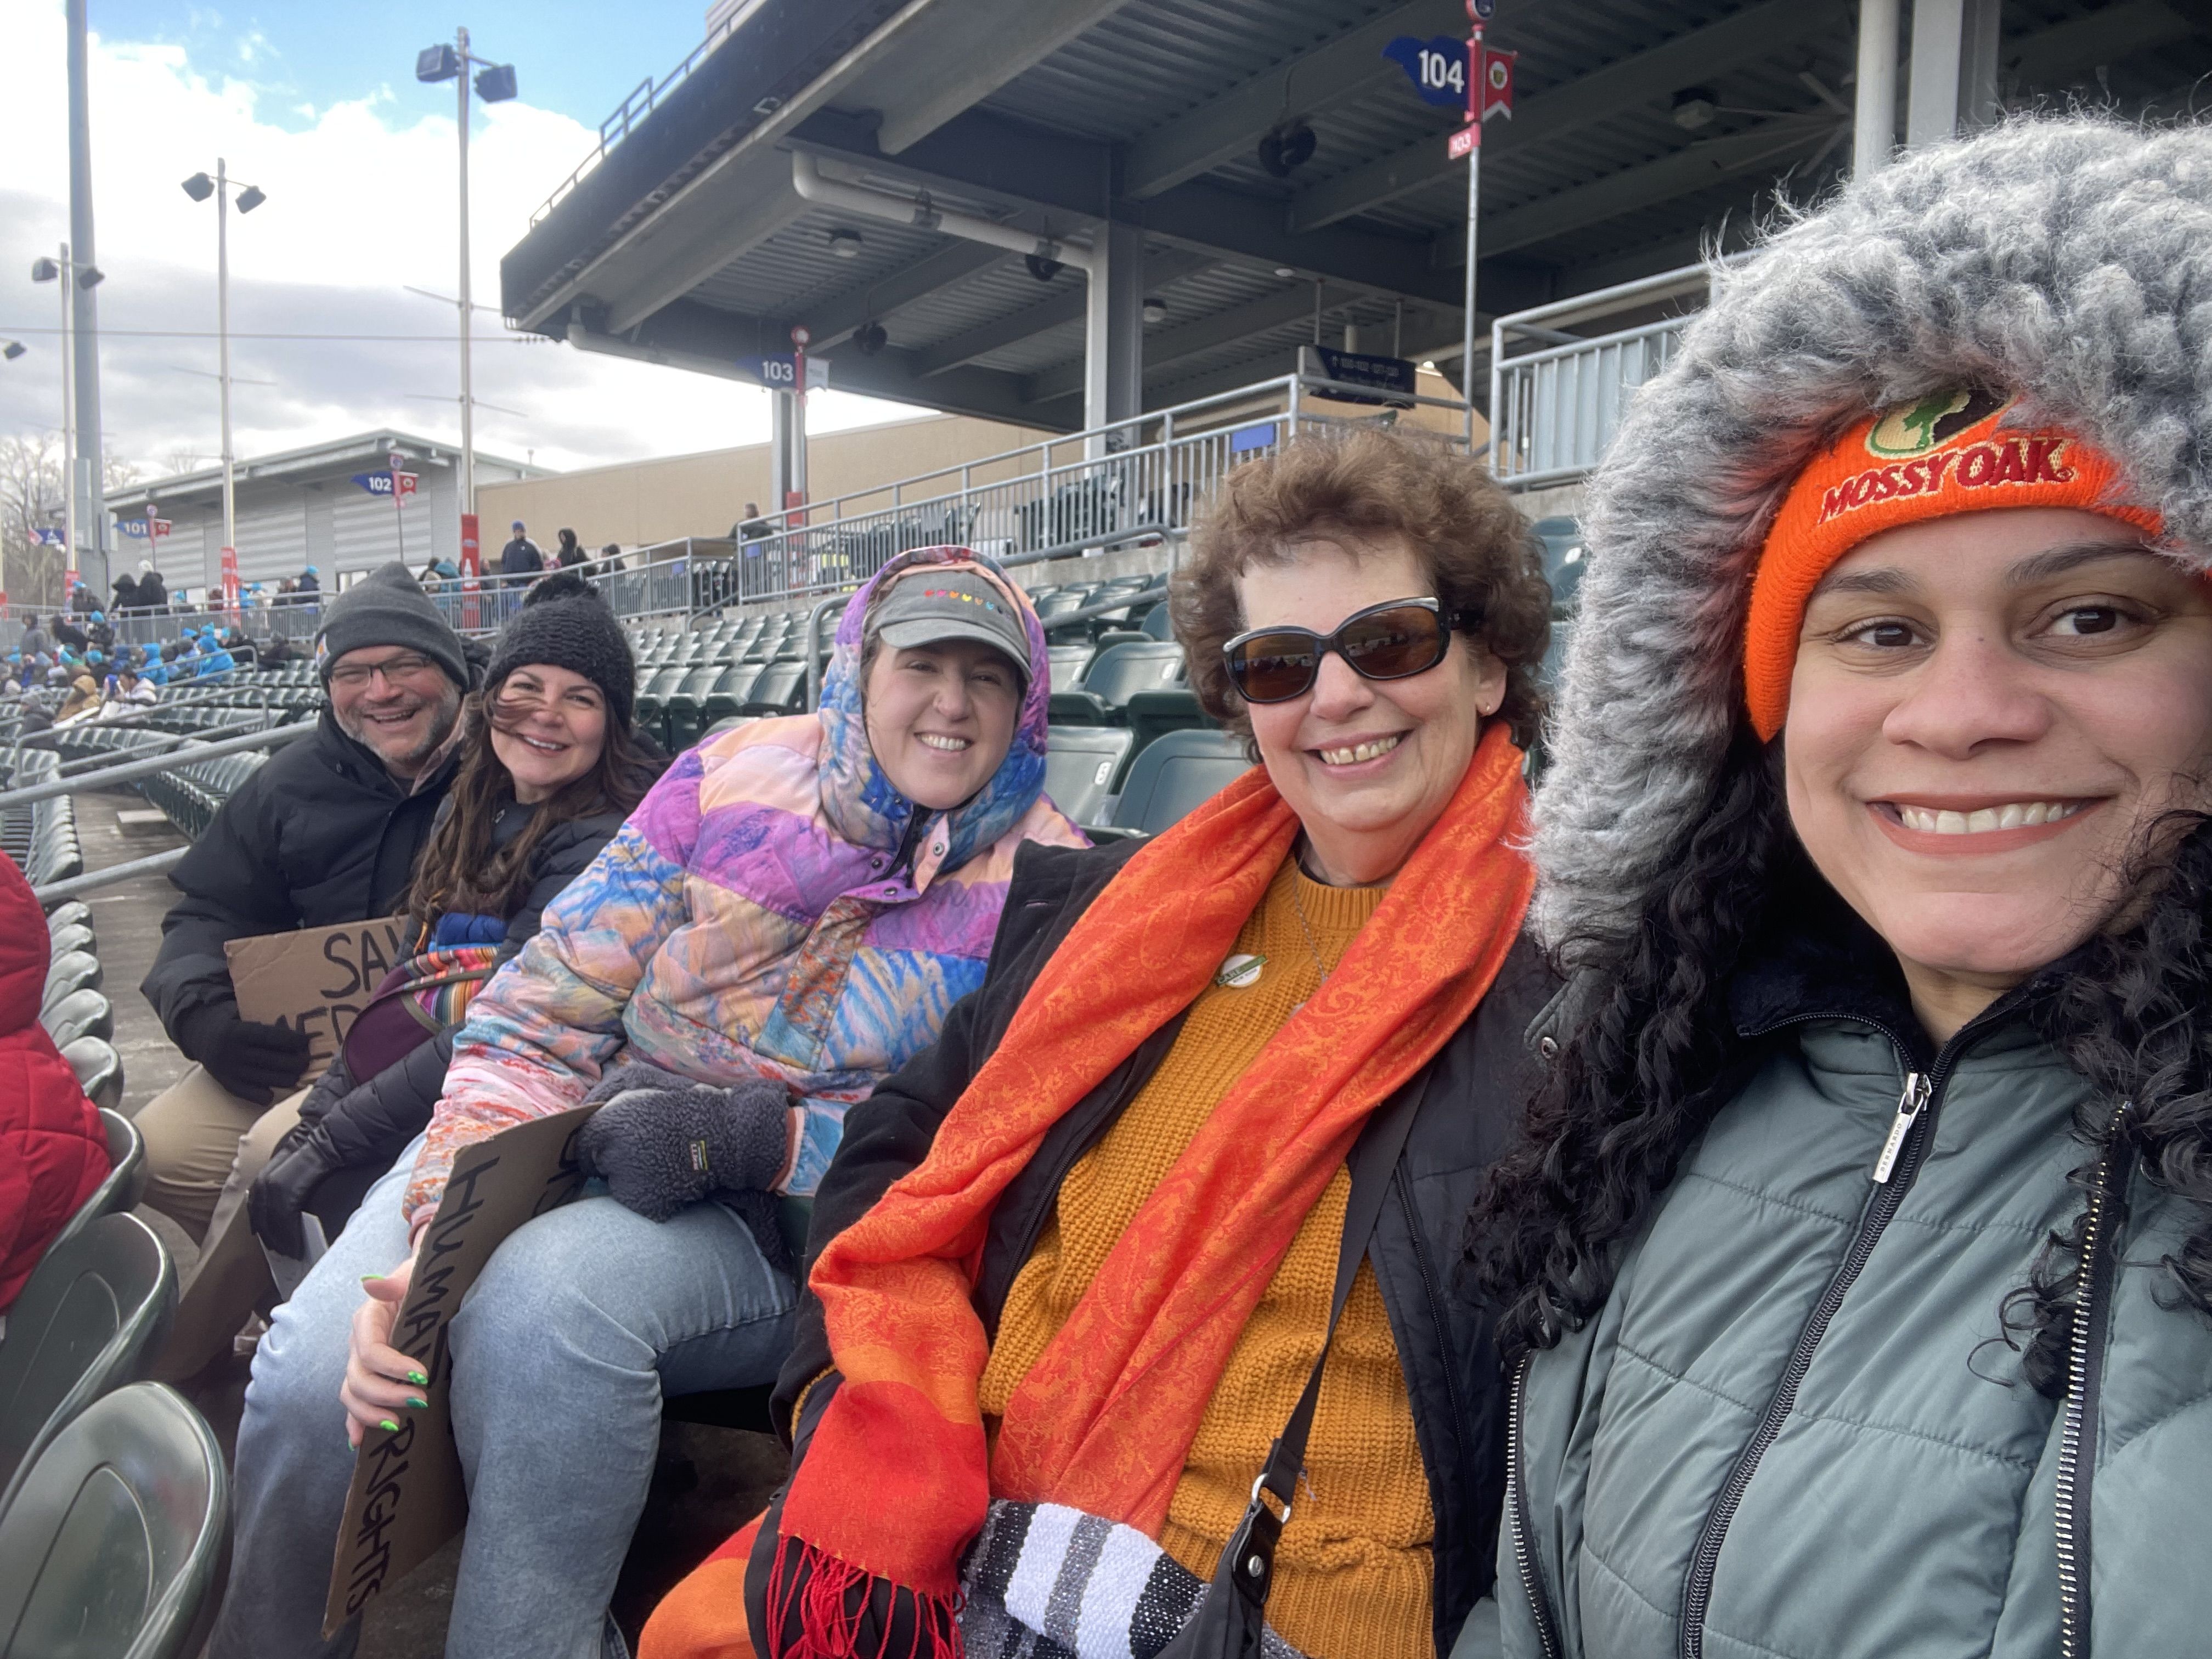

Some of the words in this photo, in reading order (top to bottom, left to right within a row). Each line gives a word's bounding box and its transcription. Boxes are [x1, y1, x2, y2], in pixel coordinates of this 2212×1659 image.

[1418, 49, 1465, 94] 104
[763, 360, 793, 382] 103
[369, 477, 392, 492] 102
[1818, 451, 1958, 525] MOSSY
[1955, 439, 2066, 487] OAK
[125, 522, 146, 535] 101
[1880, 1122, 1902, 1173] BERNARDO
[399, 1155, 500, 1361] HUMA
[346, 1416, 415, 1616] RIGHTS
